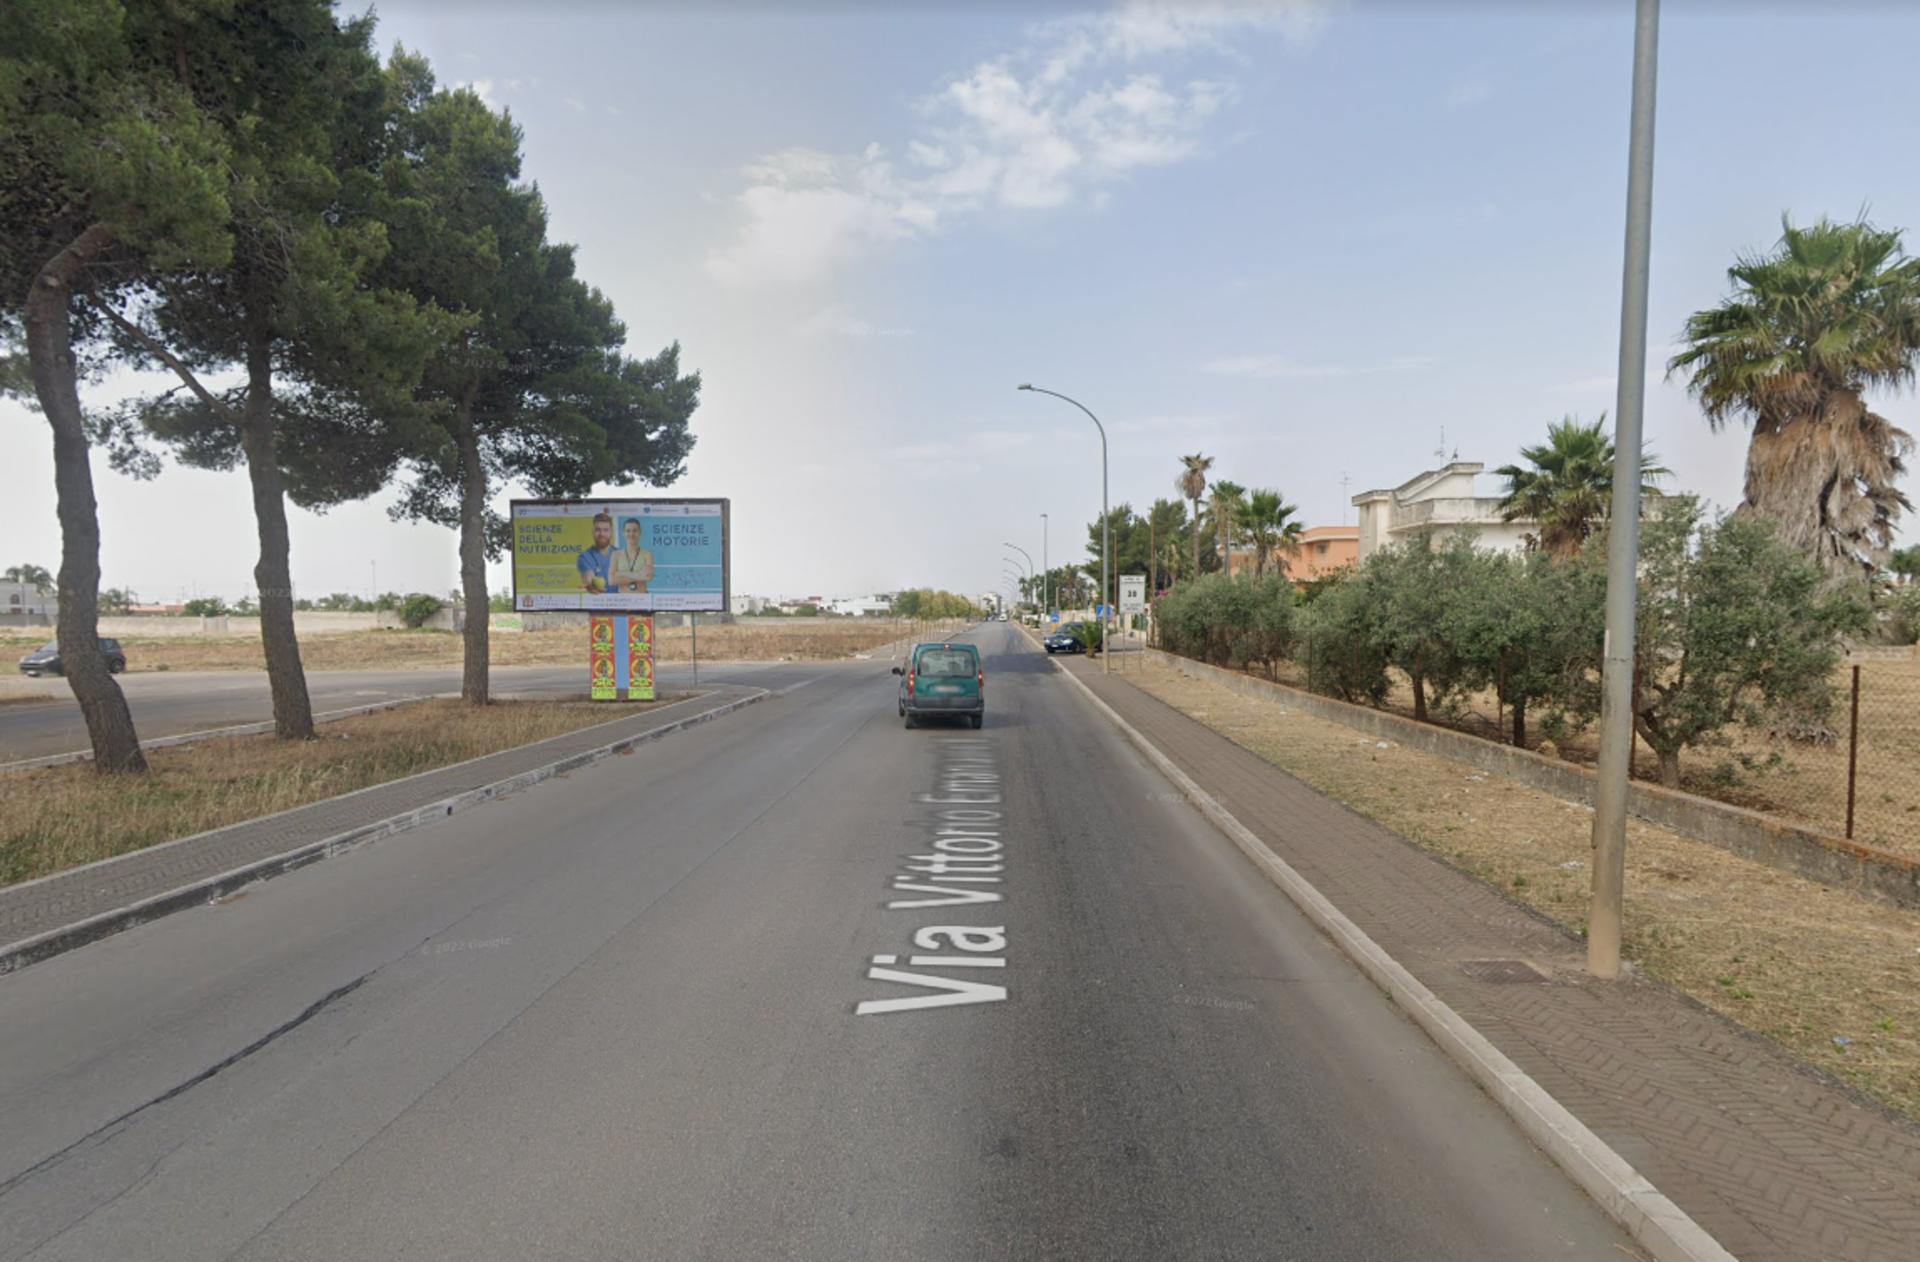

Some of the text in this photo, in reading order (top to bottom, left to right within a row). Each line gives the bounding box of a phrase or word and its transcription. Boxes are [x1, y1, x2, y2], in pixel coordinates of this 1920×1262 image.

[519, 524, 562, 533] SCIENZE
[652, 524, 705, 534] SCIENZE
[519, 534, 553, 544] DELLA
[652, 536, 710, 547] MOTORIE
[519, 544, 583, 554] NUTRIZIONE
